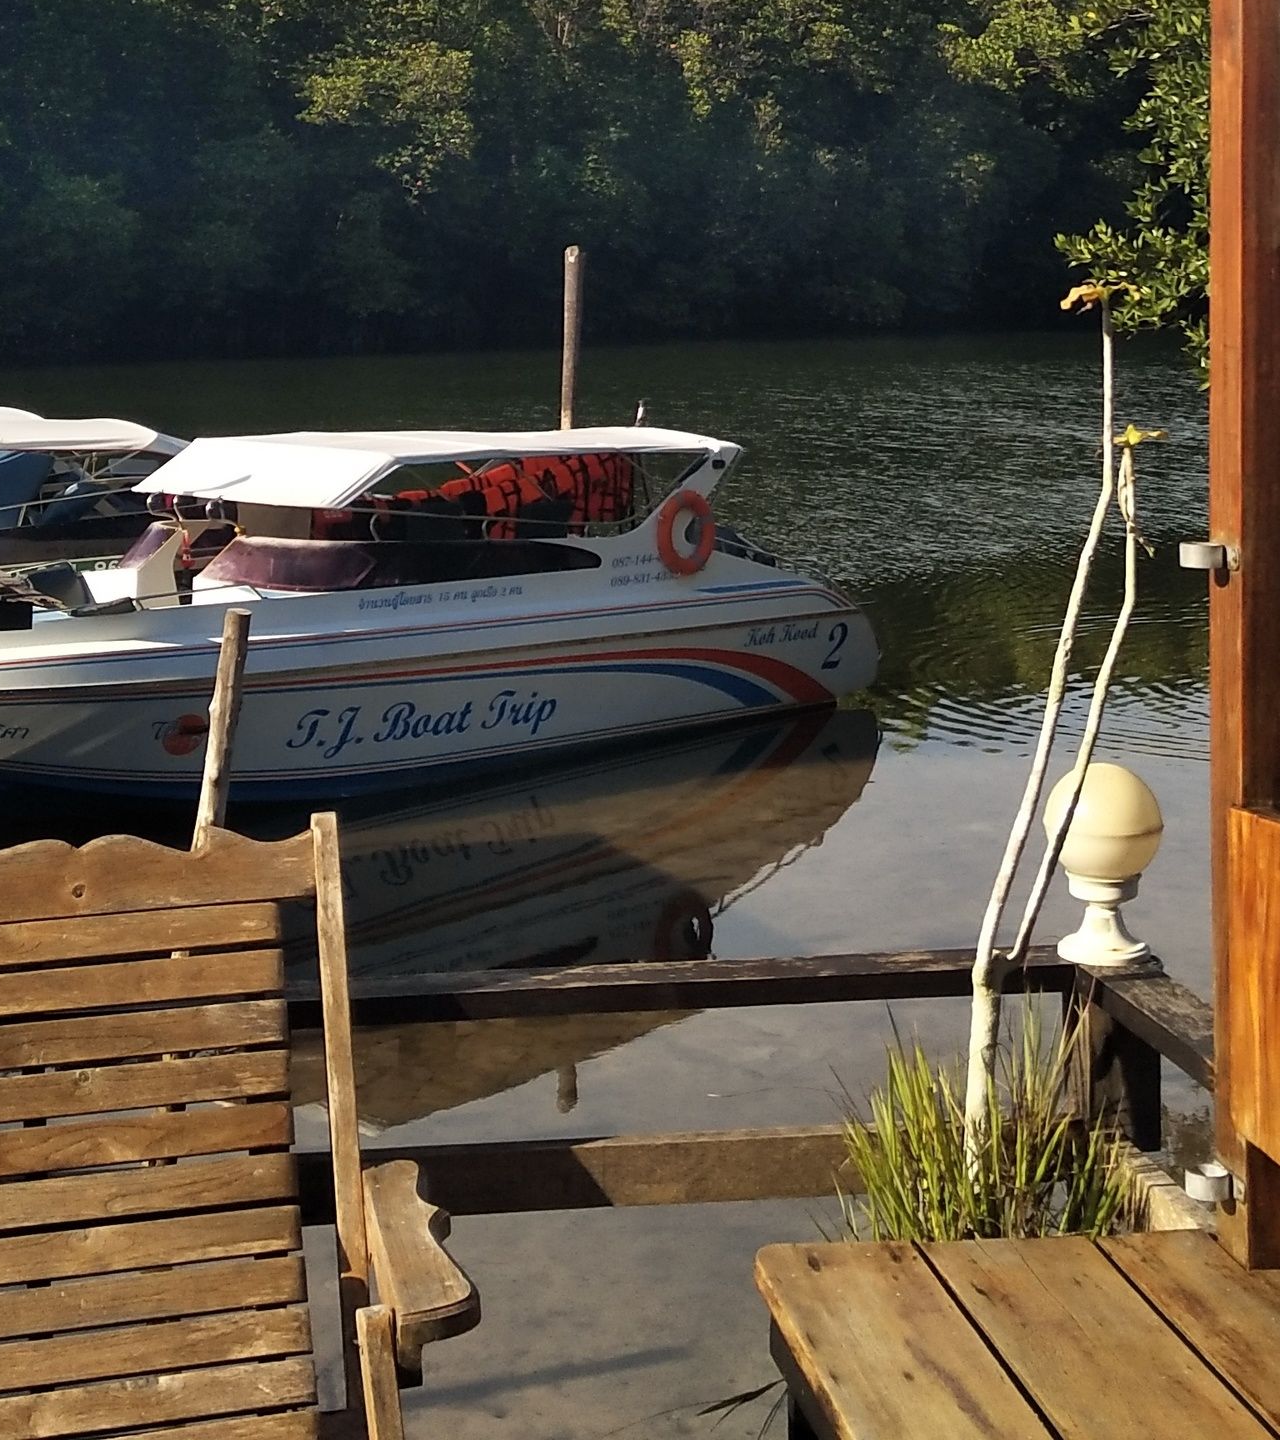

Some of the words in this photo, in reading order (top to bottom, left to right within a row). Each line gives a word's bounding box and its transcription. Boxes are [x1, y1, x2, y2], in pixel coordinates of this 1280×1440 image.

[743, 626, 776, 648] Koh
[821, 622, 848, 670] 2
[286, 705, 364, 759] T.J.
[373, 701, 473, 743] Boat
[481, 689, 558, 736] Trip
